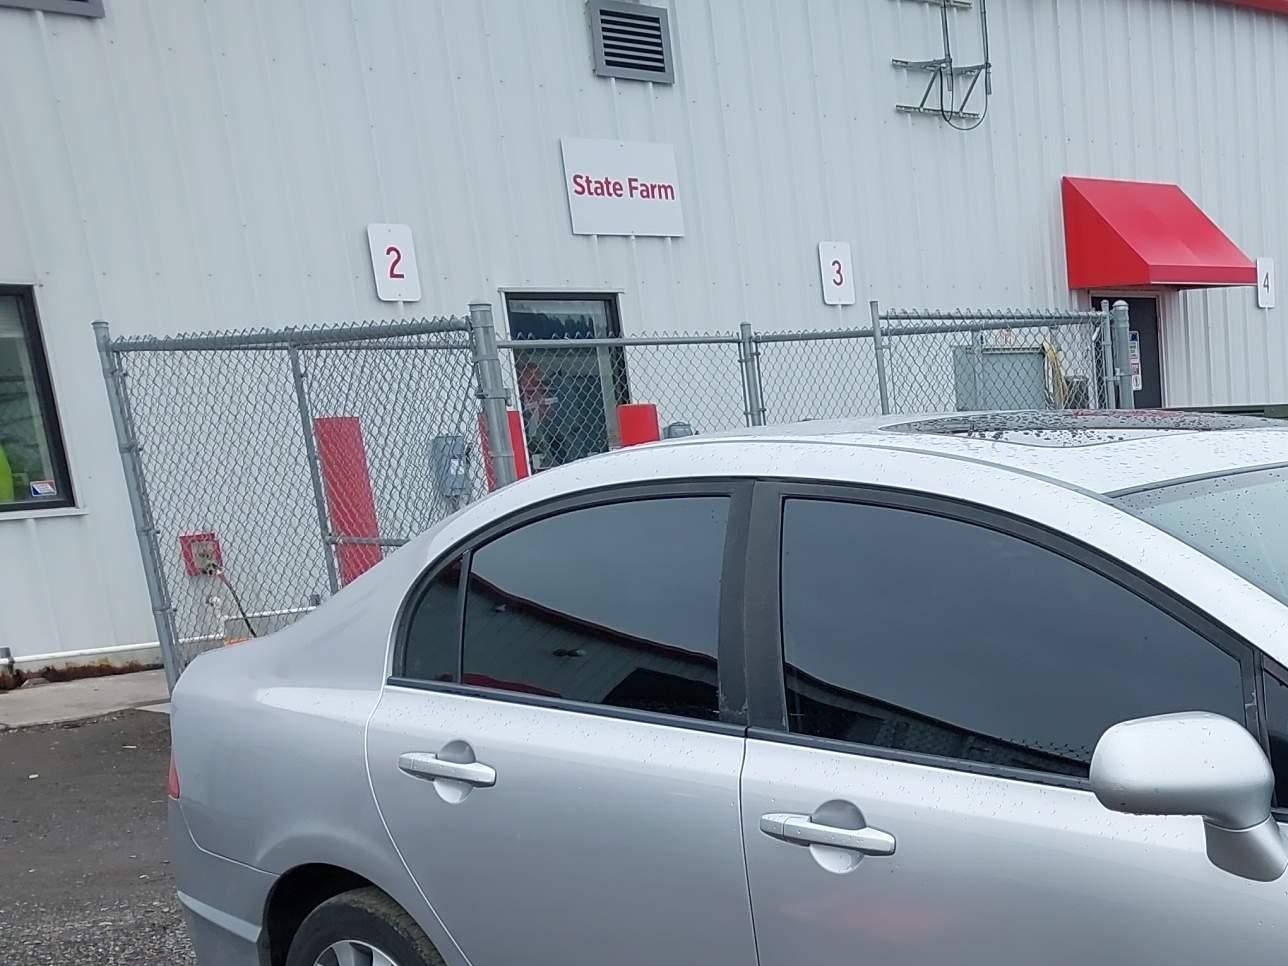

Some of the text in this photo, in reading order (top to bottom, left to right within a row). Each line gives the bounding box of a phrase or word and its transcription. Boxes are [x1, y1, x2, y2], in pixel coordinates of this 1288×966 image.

[572, 174, 676, 201] State Farm
[385, 246, 405, 279] 2
[831, 259, 844, 287] 3
[1262, 271, 1270, 294] 4
